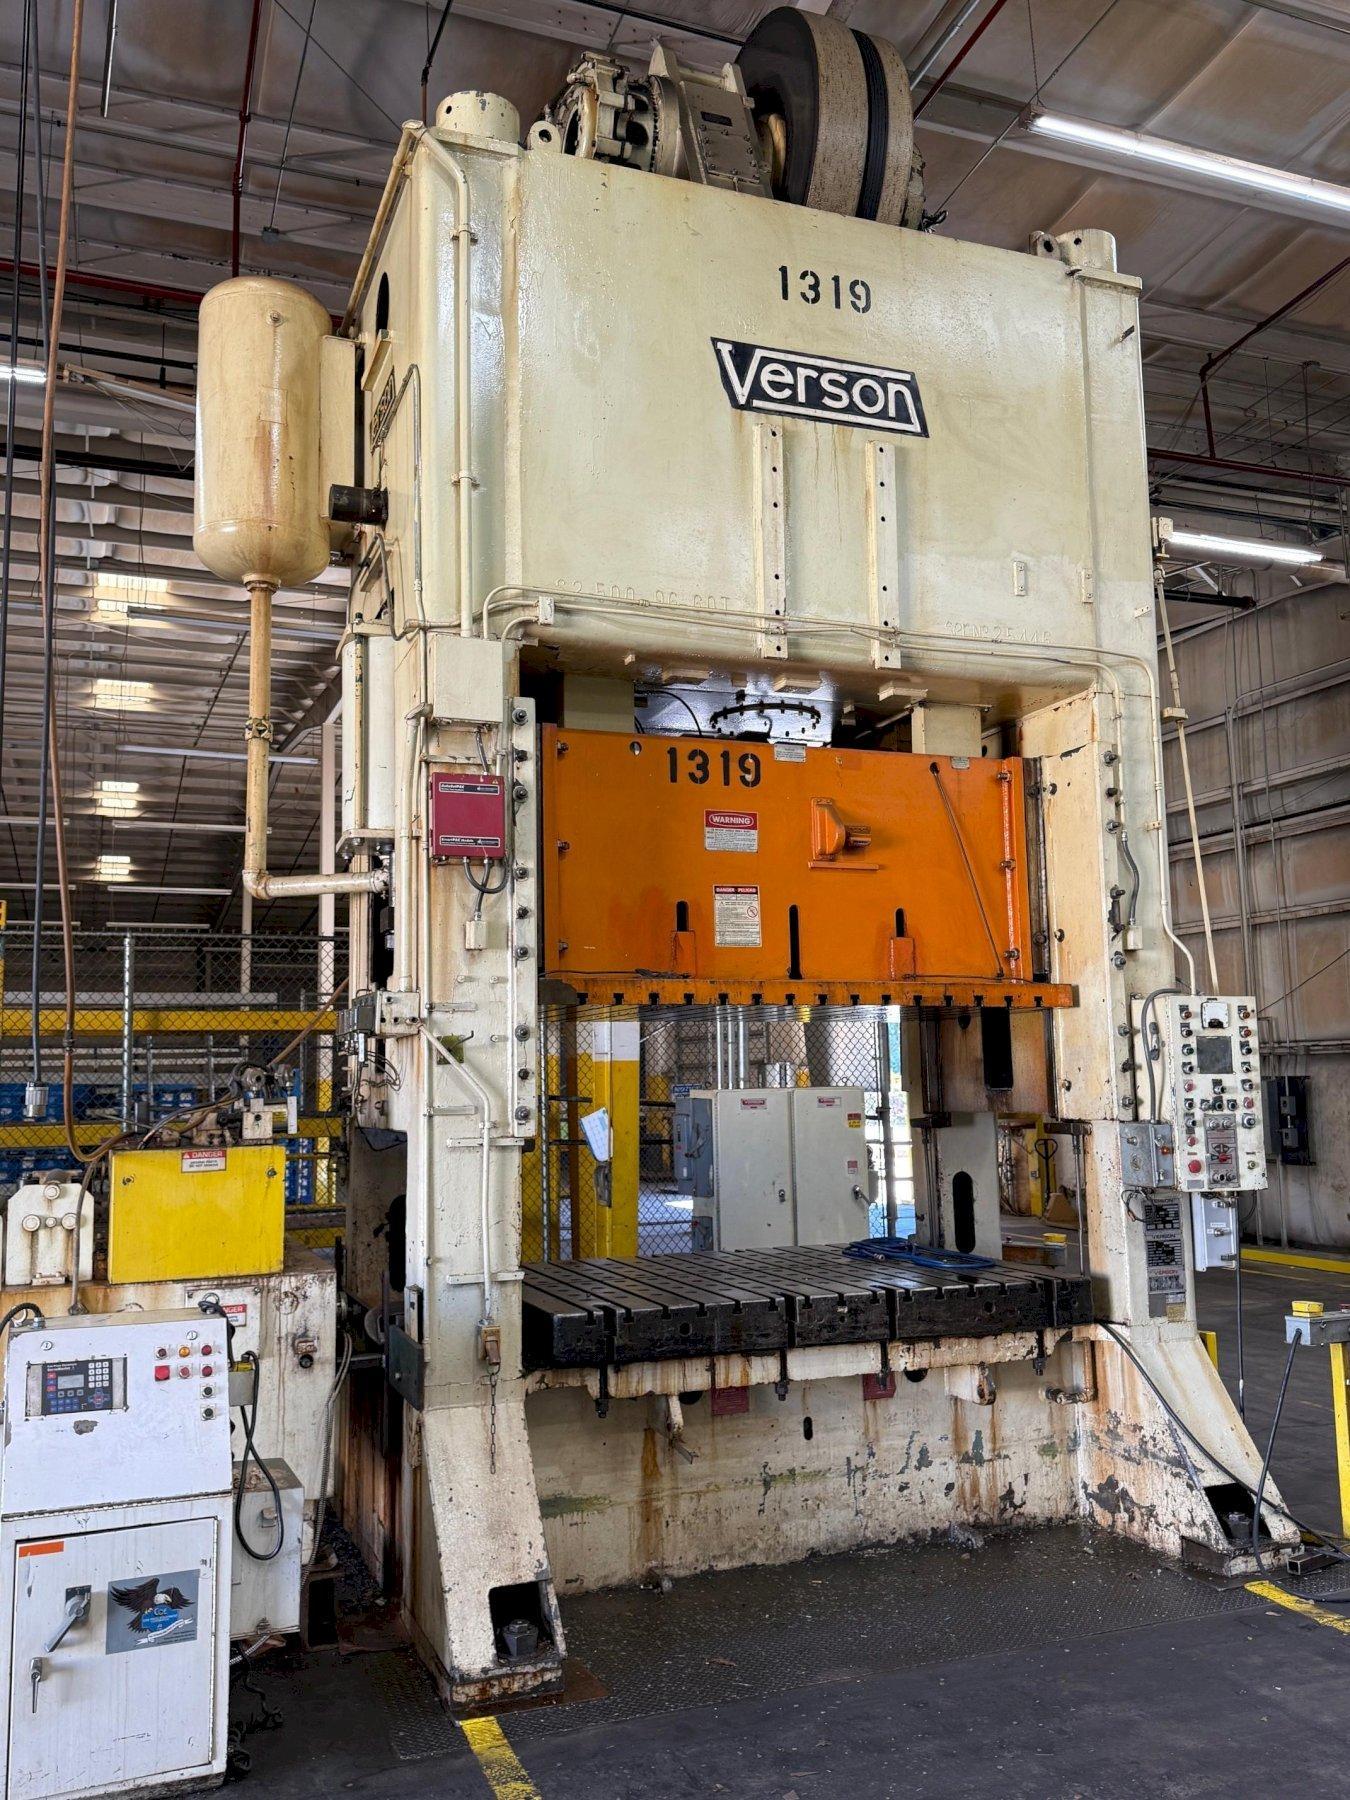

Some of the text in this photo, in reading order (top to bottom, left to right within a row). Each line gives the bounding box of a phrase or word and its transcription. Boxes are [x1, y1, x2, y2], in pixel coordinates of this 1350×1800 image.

[778, 265, 872, 314] 1319
[716, 341, 922, 433] Verson
[667, 747, 761, 788] 1319
[712, 816, 751, 825] WARNING
